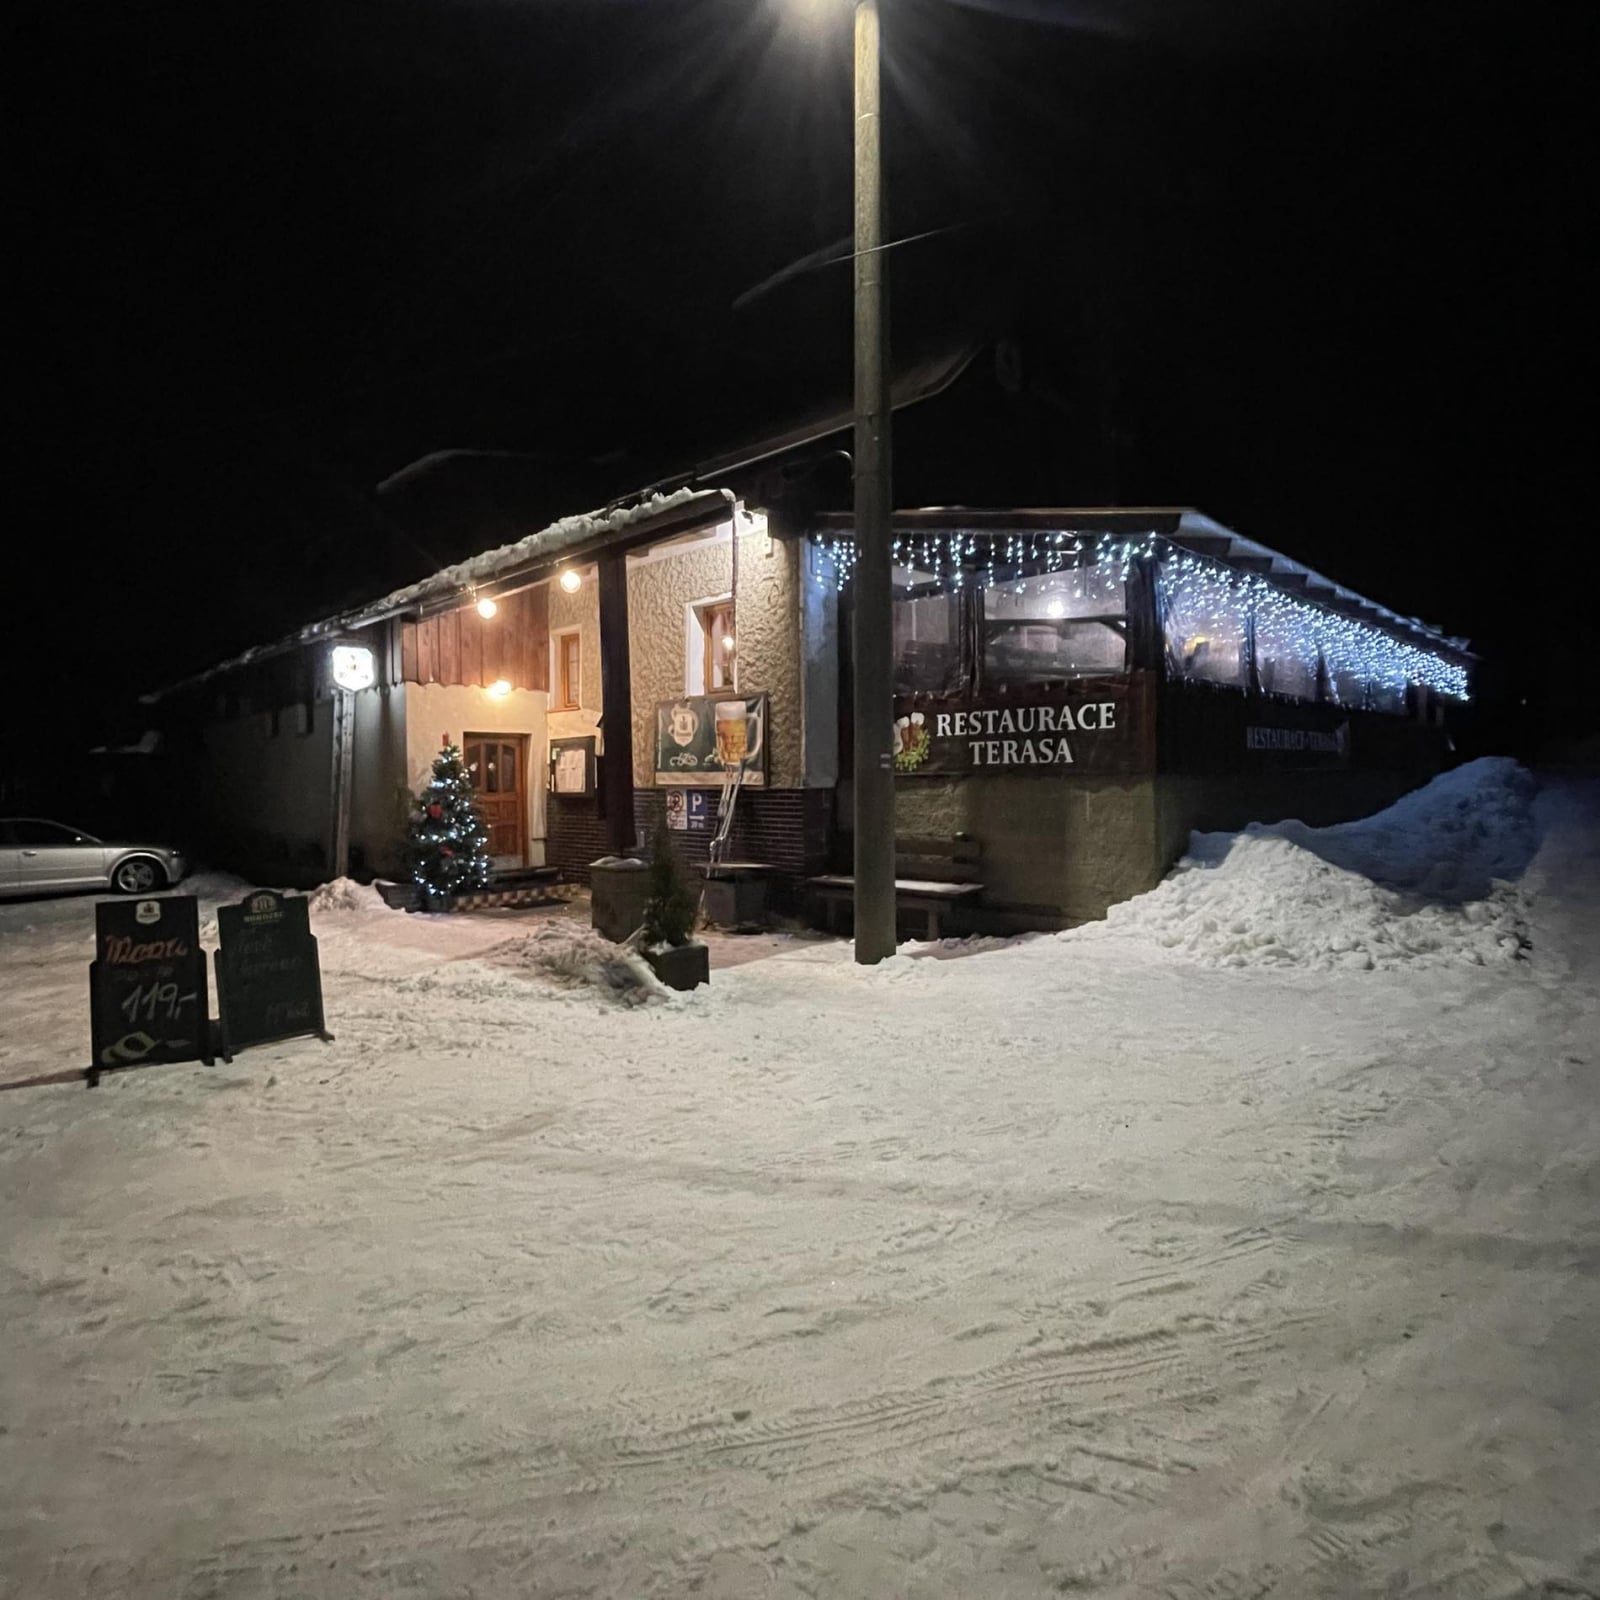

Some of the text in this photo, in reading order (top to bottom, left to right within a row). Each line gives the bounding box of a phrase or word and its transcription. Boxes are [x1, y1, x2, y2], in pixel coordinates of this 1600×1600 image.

[936, 702, 1116, 737] RESTAURACE
[969, 738, 1073, 765] TERASA
[692, 792, 702, 812] P
